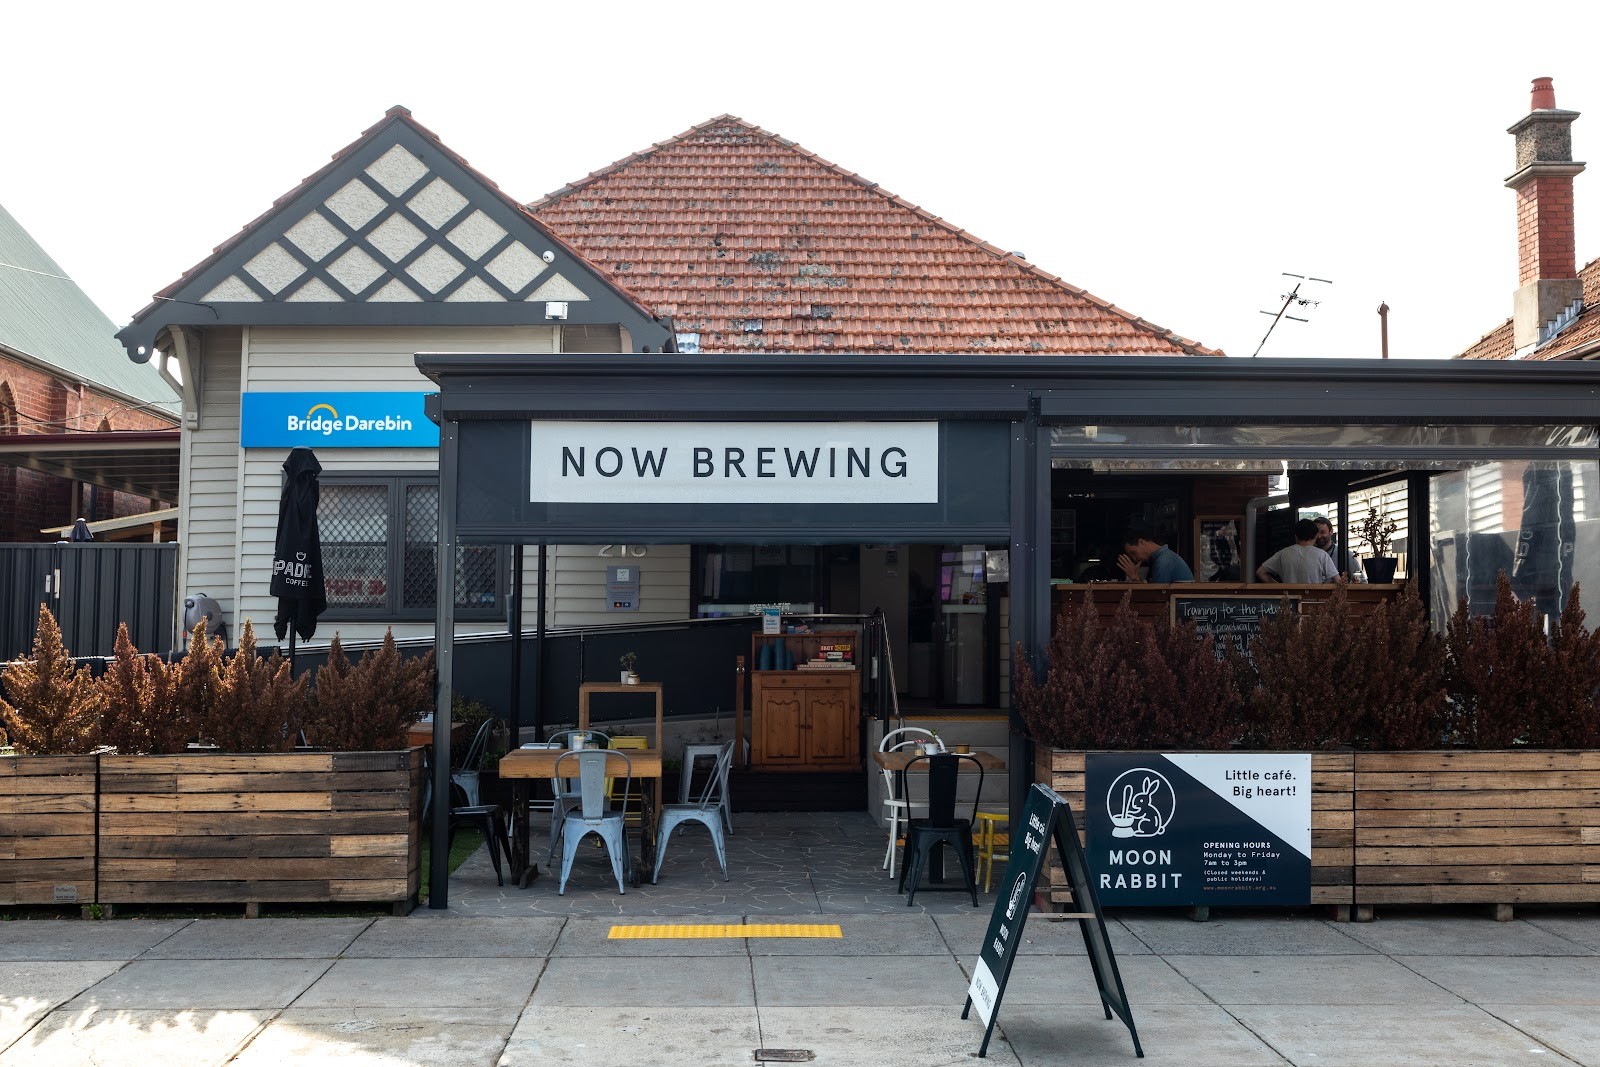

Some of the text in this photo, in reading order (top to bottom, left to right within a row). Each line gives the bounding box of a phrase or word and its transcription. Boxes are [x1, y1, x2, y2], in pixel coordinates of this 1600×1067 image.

[287, 414, 412, 435] Bridge Darebin
[561, 447, 908, 478] NOW BREWING
[1179, 601, 1218, 623] Training
[1220, 602, 1237, 618] for
[1239, 603, 1258, 616] the
[1225, 769, 1297, 780] Little café.
[1233, 785, 1297, 798] Big heart!
[1109, 850, 1172, 865] MOON
[1203, 851, 1232, 859] Monday
[1251, 851, 1281, 859] Friday
[1233, 859, 1247, 867] 3pm
[1100, 873, 1183, 888] RABBIT
